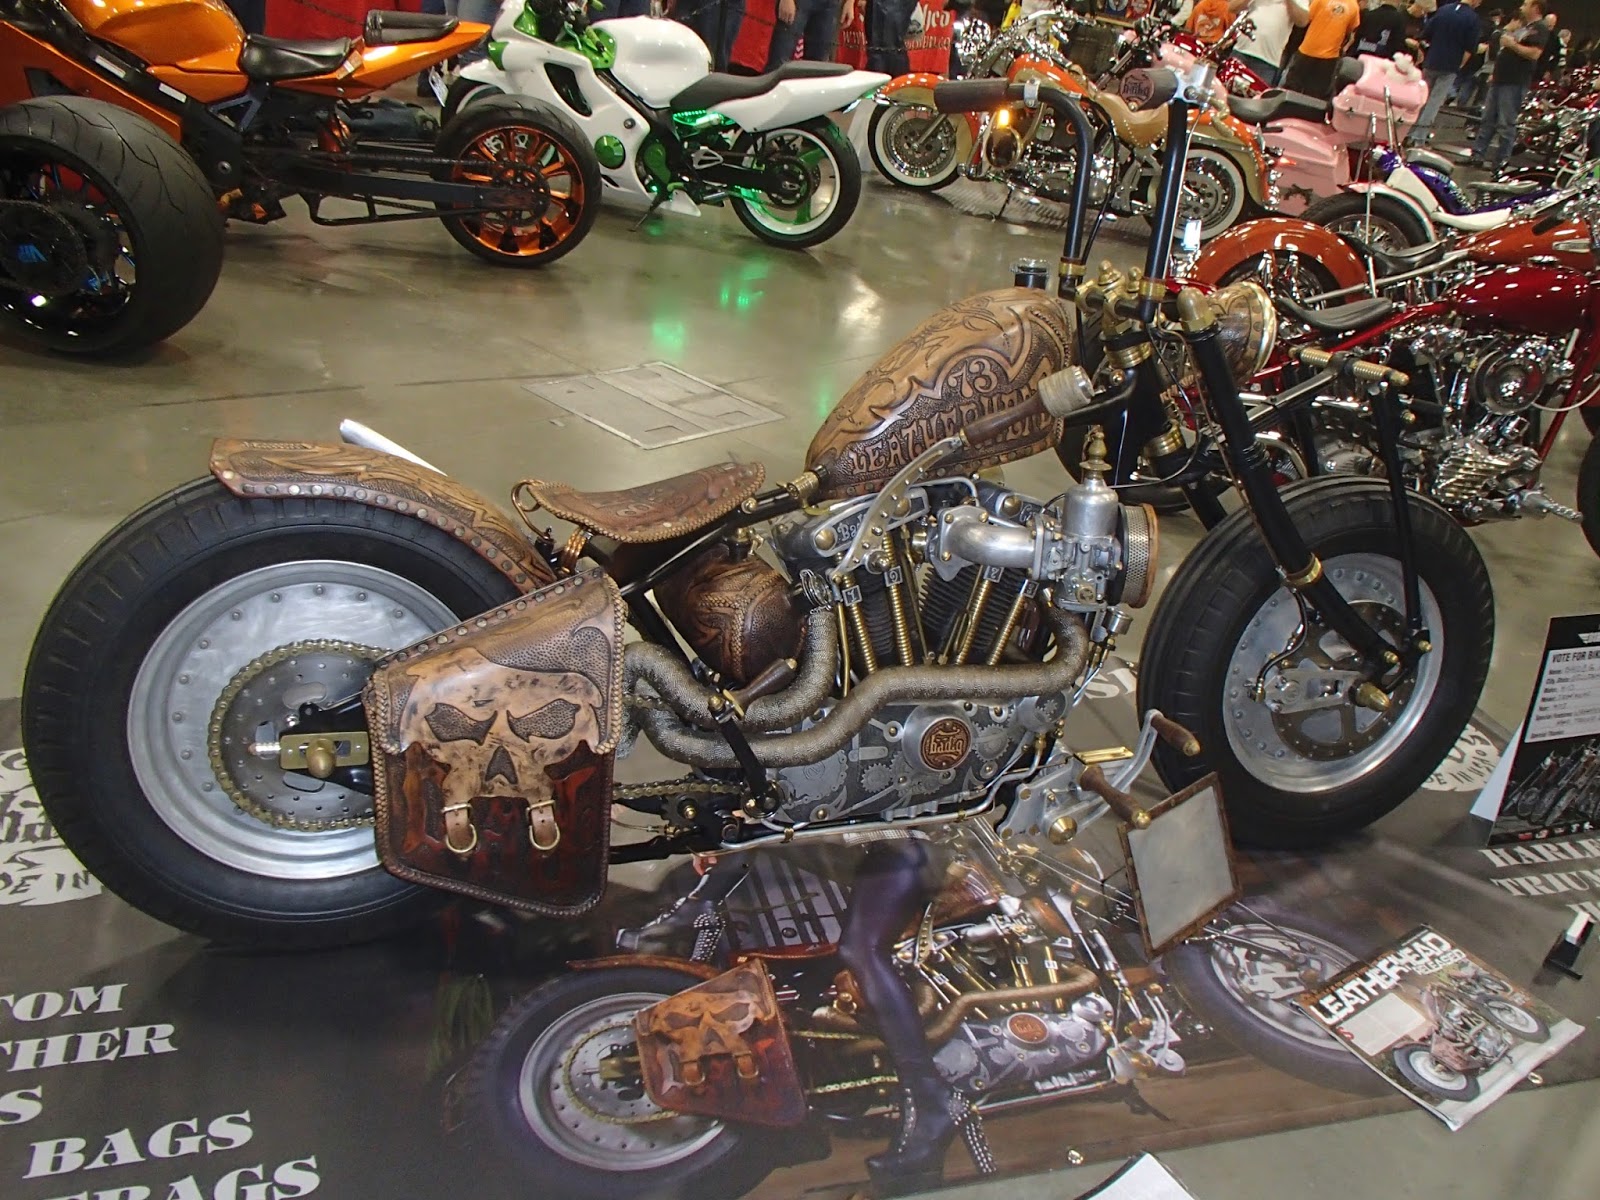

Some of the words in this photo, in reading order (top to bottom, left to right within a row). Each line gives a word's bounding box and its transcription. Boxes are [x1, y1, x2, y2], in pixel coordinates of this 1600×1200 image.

[948, 358, 998, 397] 73
[55, 869, 91, 892] IN
[1309, 931, 1453, 1026] LEATHERHEAD
[1414, 948, 1467, 976] RELEASED
[22, 1109, 253, 1179] BAGS
